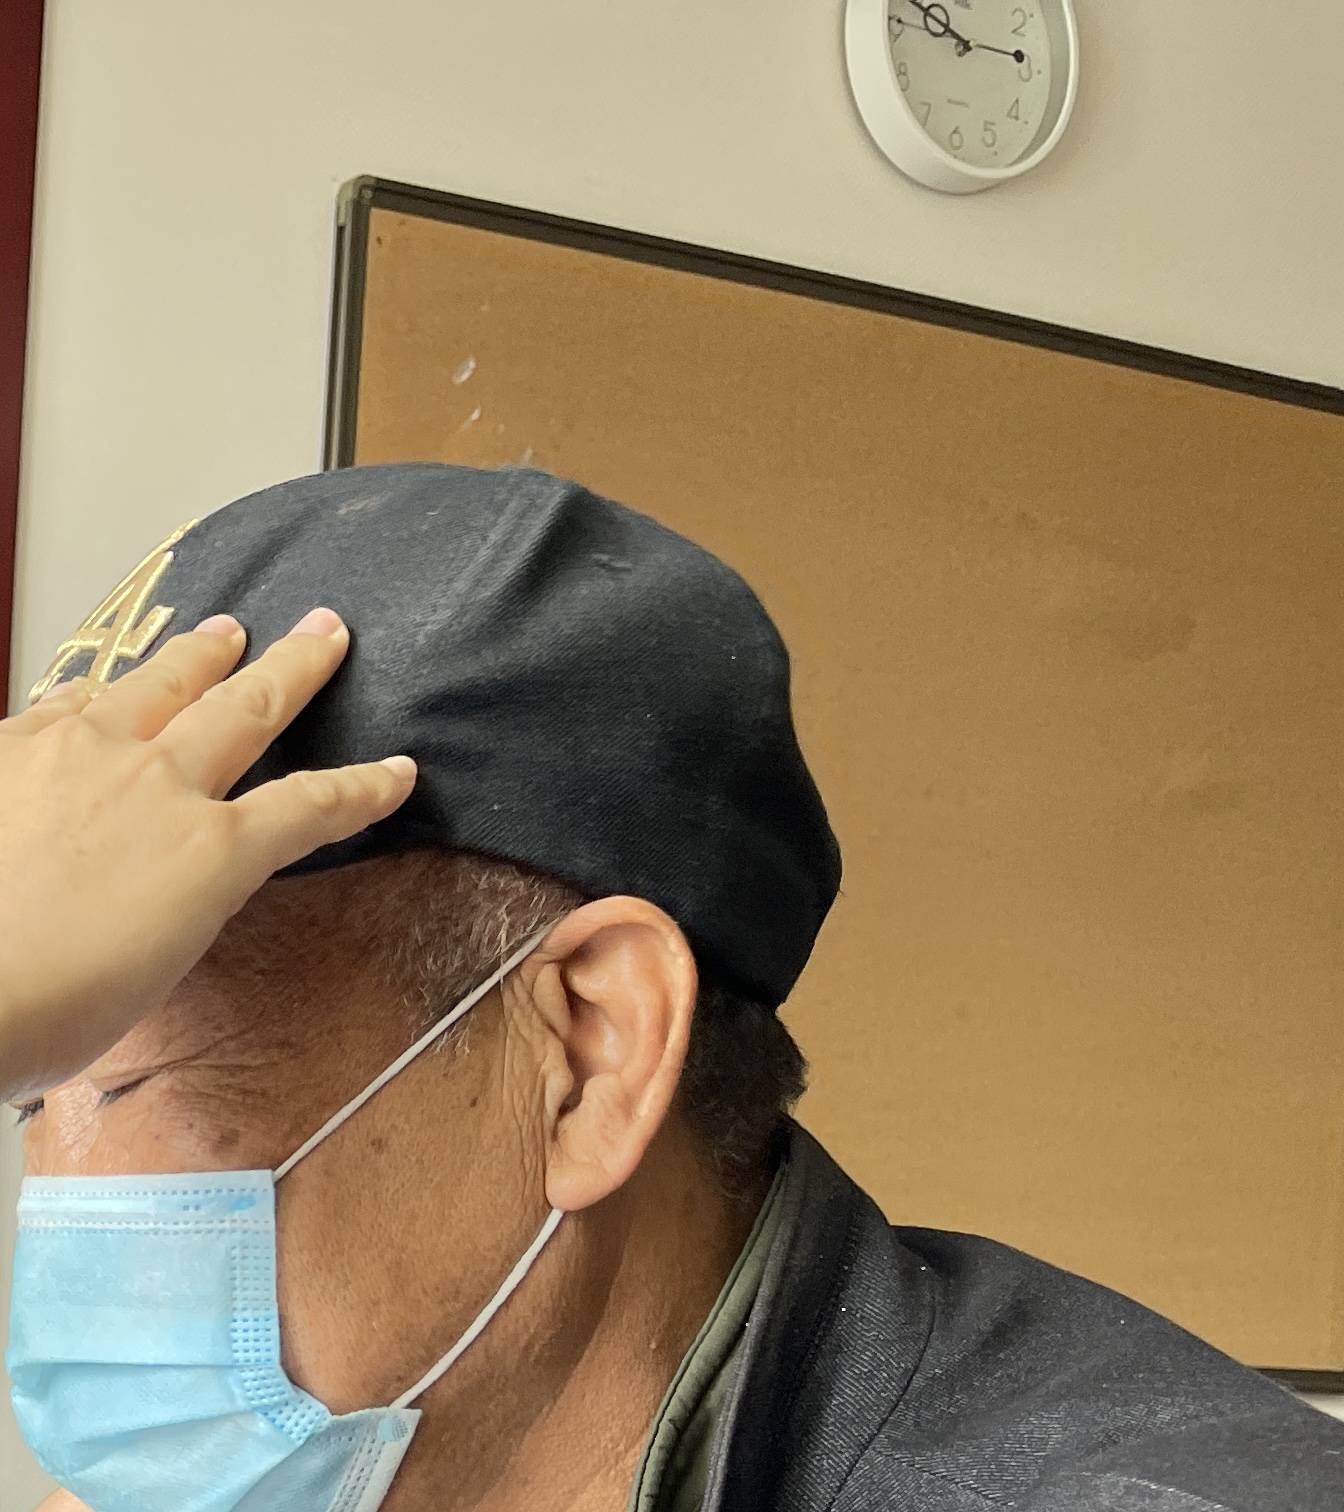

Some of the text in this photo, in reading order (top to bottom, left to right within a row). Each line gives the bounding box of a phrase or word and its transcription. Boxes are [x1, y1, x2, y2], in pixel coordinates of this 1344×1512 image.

[1011, 7, 1027, 37] 2
[897, 61, 910, 92] 8
[919, 101, 932, 128] 7
[1006, 96, 1020, 121] 4
[948, 125, 964, 150] 6
[982, 120, 997, 148] 5
